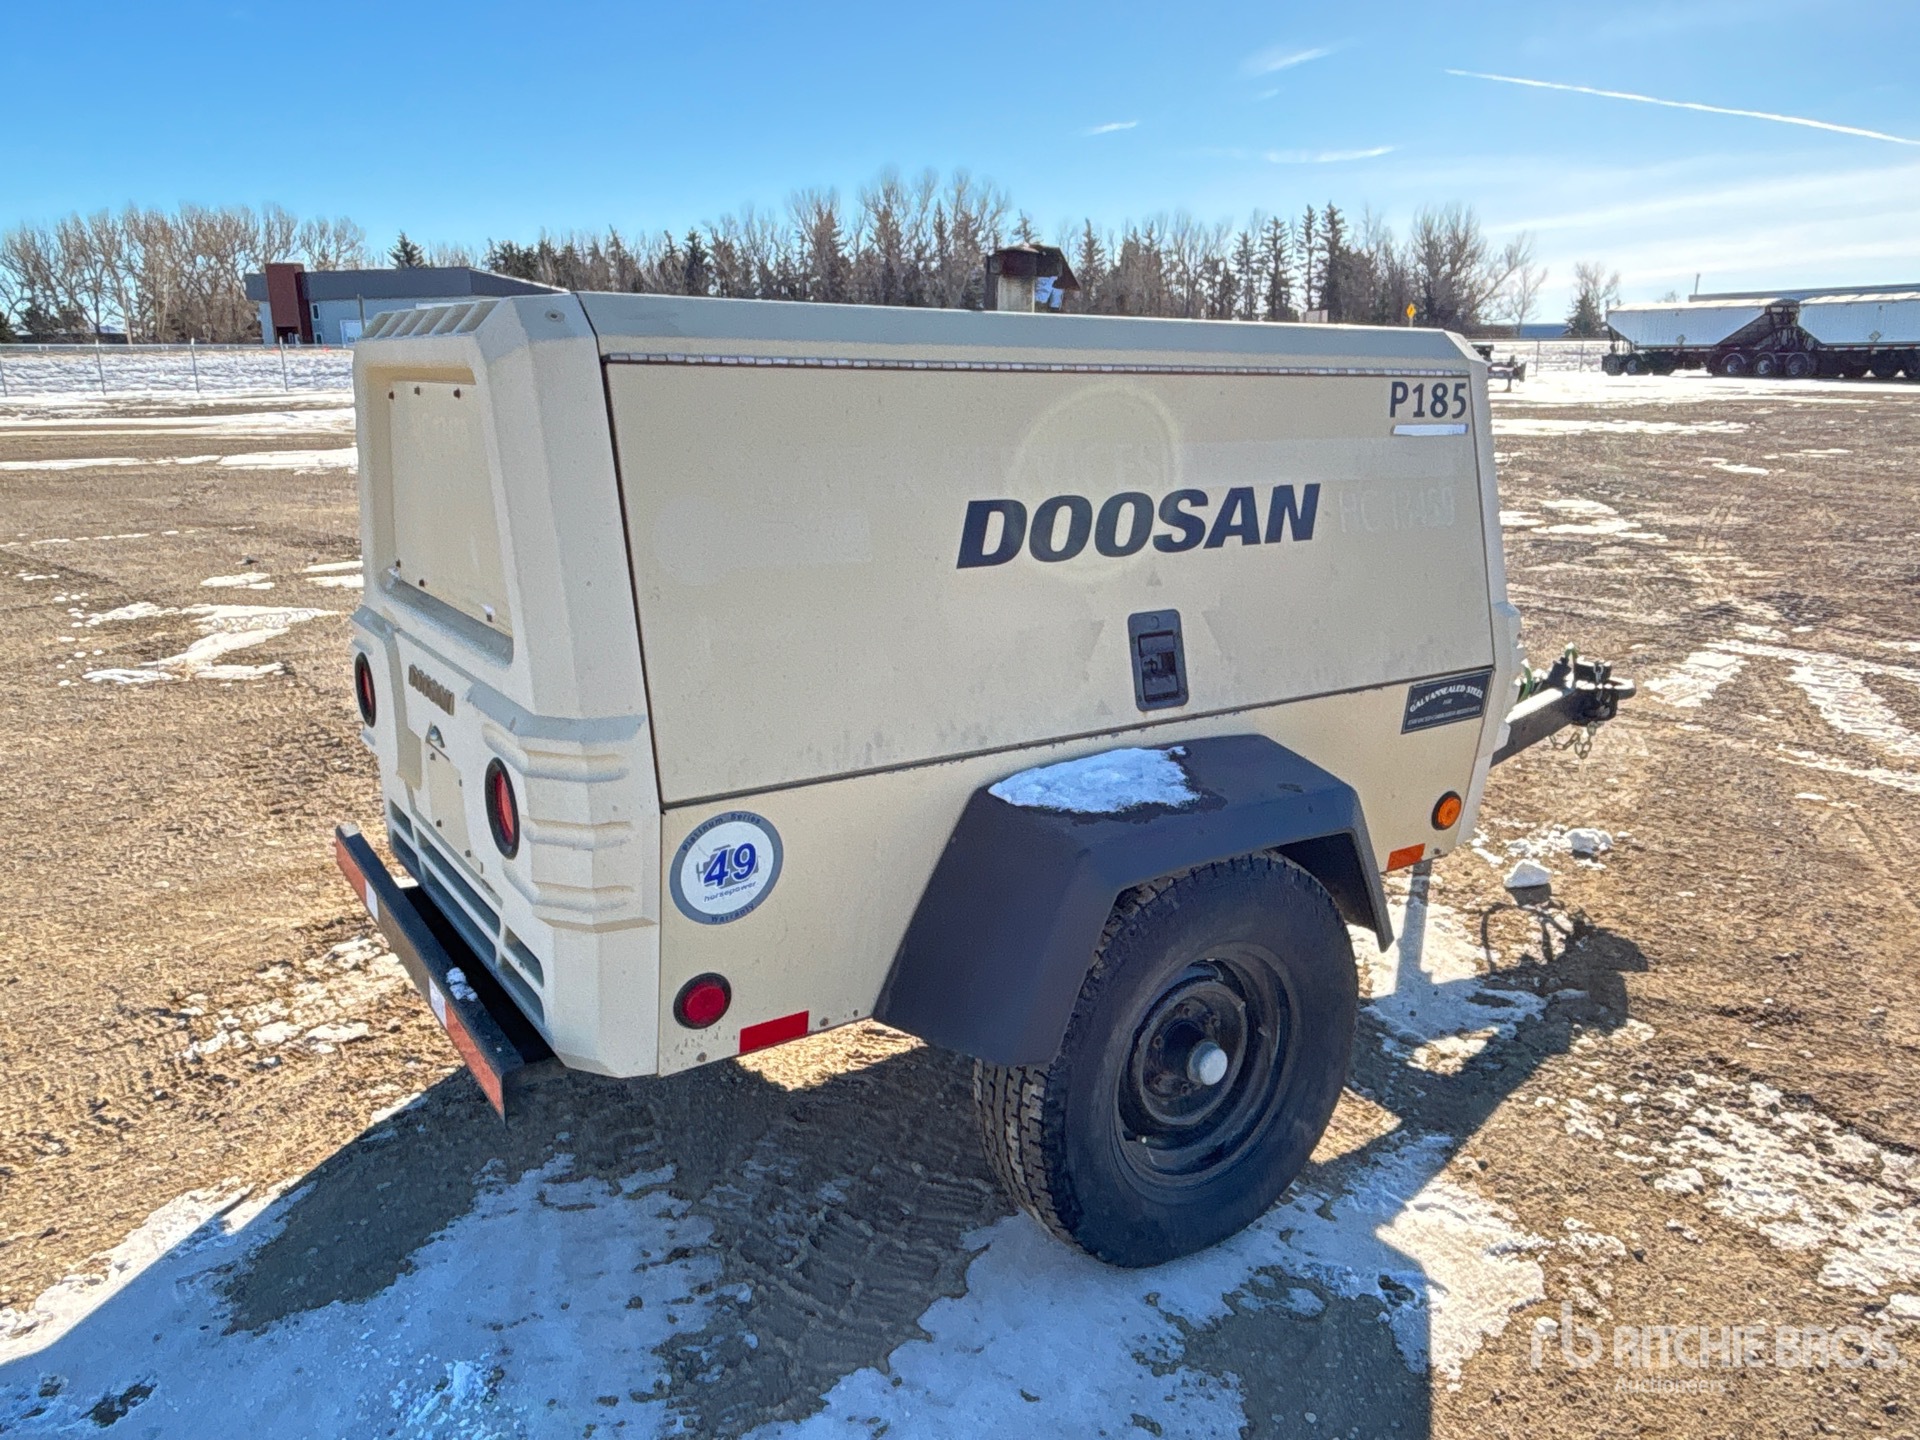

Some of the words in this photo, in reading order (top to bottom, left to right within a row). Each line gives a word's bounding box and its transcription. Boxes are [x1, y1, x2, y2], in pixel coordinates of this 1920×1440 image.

[1390, 382, 1468, 418] P185
[956, 482, 1321, 569] DOOSAN
[682, 817, 724, 852] Platinum
[730, 812, 762, 825] Series
[703, 842, 757, 887] 49
[703, 881, 757, 903] horsepower
[711, 902, 755, 923] Warranty
